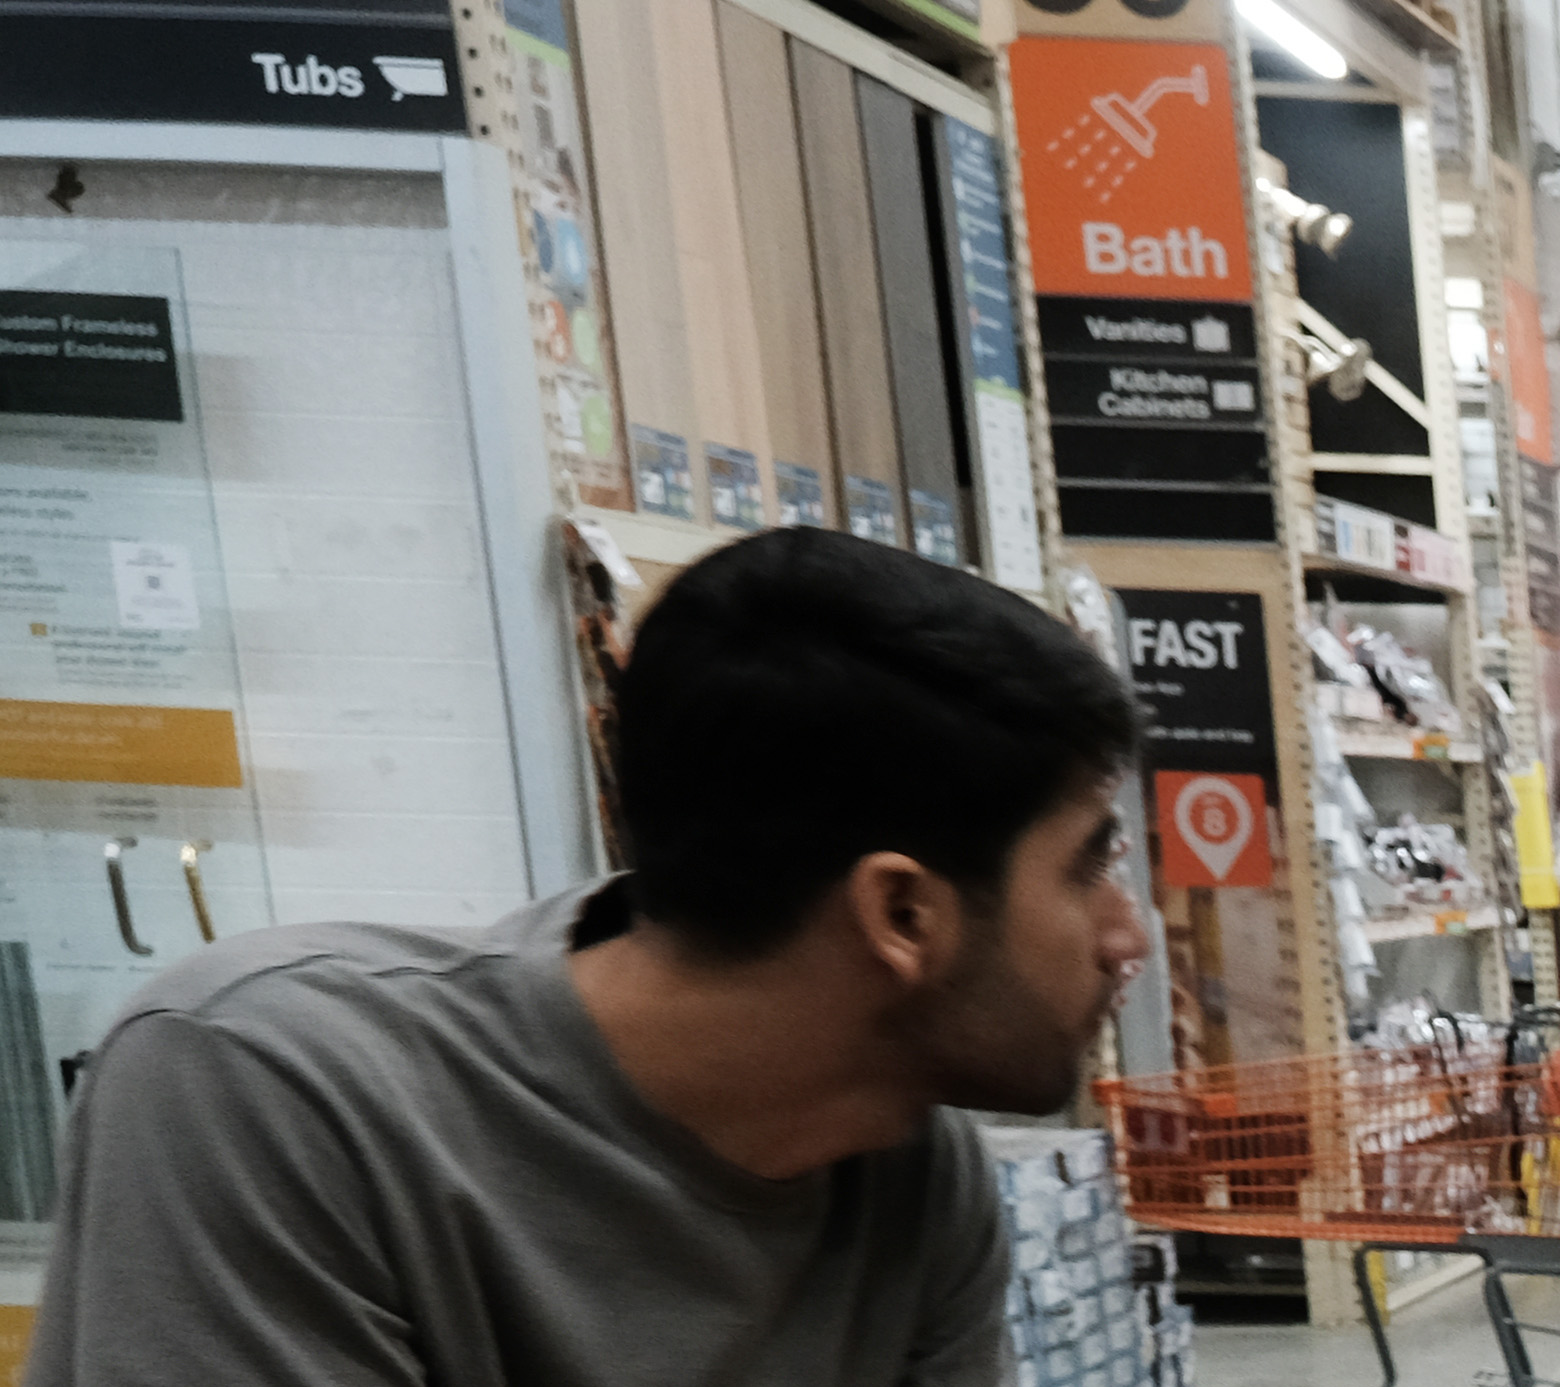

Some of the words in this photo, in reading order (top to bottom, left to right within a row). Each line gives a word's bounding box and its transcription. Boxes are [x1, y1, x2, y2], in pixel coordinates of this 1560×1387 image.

[252, 52, 364, 98] Tubs
[1081, 221, 1228, 279] Bath
[1083, 315, 1187, 344] Vanities
[1109, 367, 1209, 394] Kitchen
[1097, 391, 1211, 419] Cabinets
[1129, 618, 1244, 669] FAST
